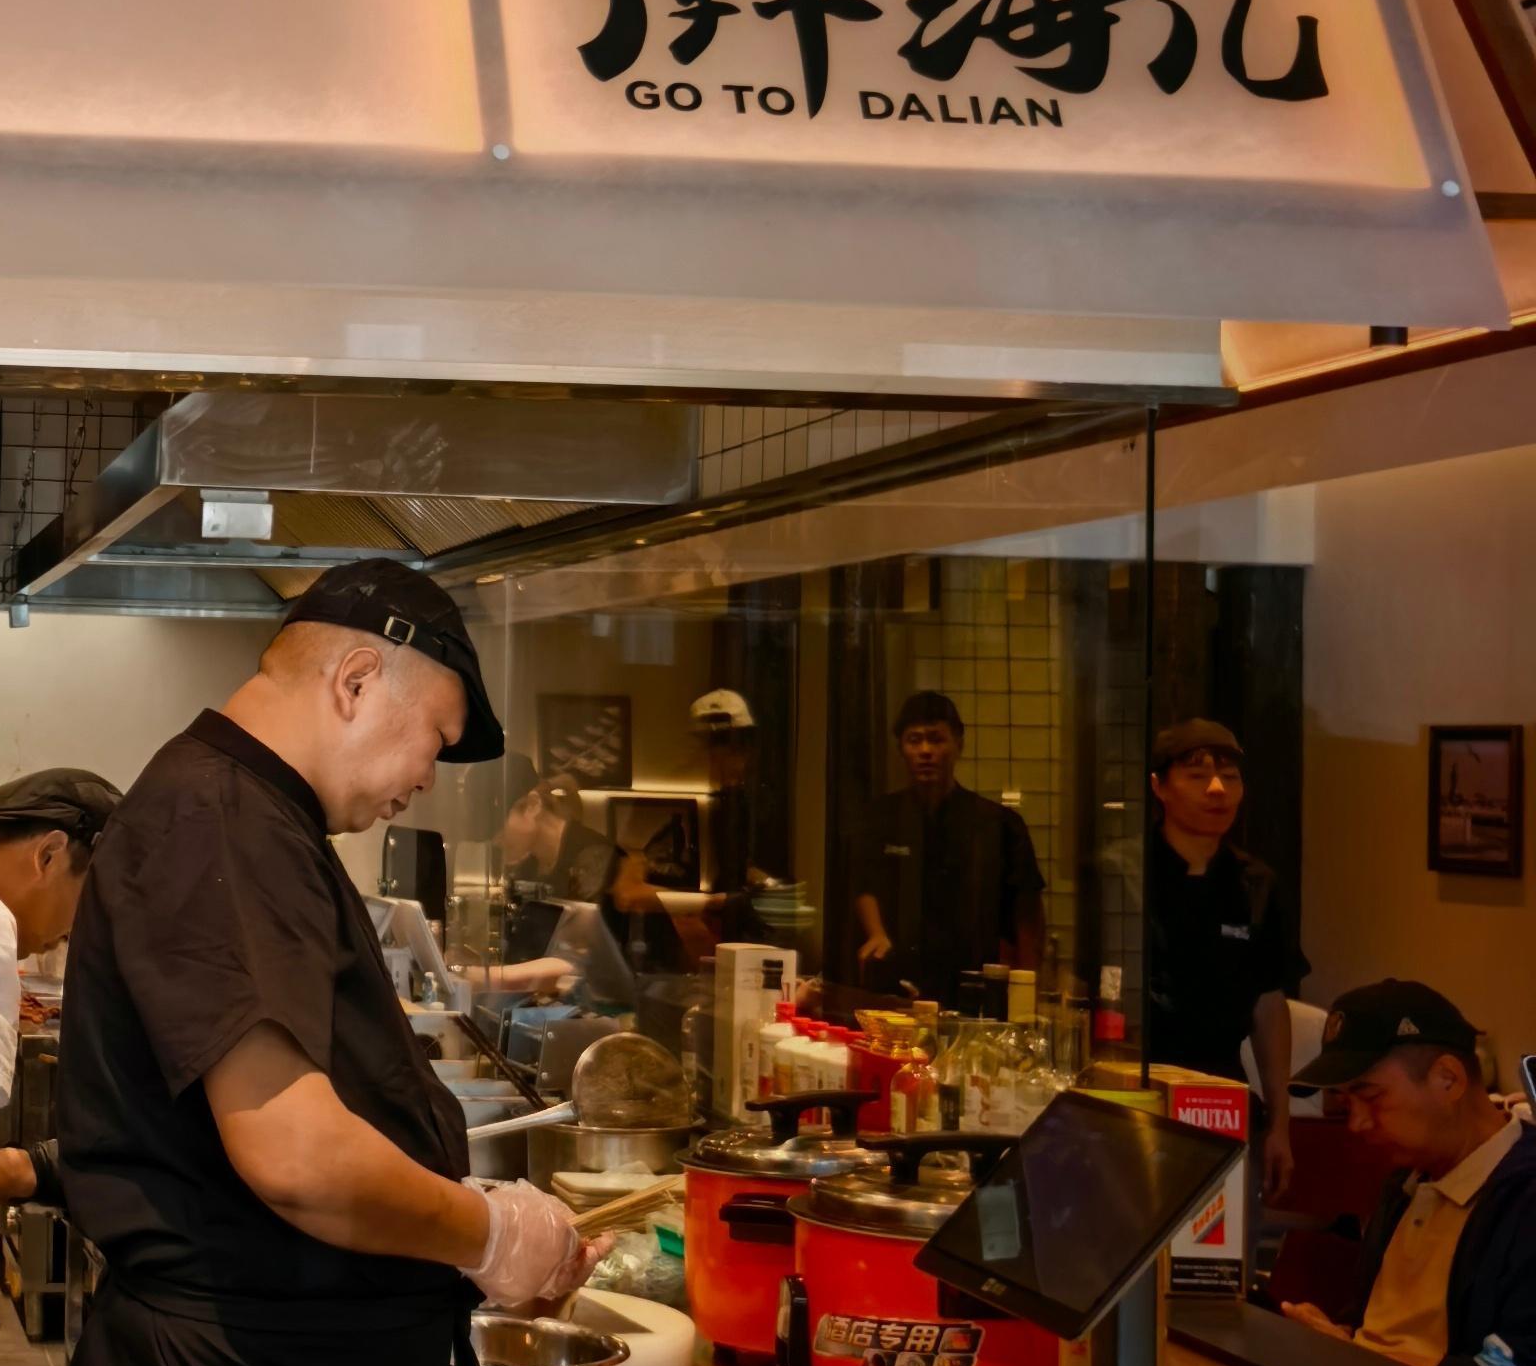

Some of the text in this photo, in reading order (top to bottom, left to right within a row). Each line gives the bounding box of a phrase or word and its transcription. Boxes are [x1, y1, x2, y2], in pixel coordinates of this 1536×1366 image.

[625, 80, 1064, 127] GO TO DALIAN
[1177, 1106, 1240, 1132] MOUTAI
[824, 1315, 940, 1353] 酒店专用
